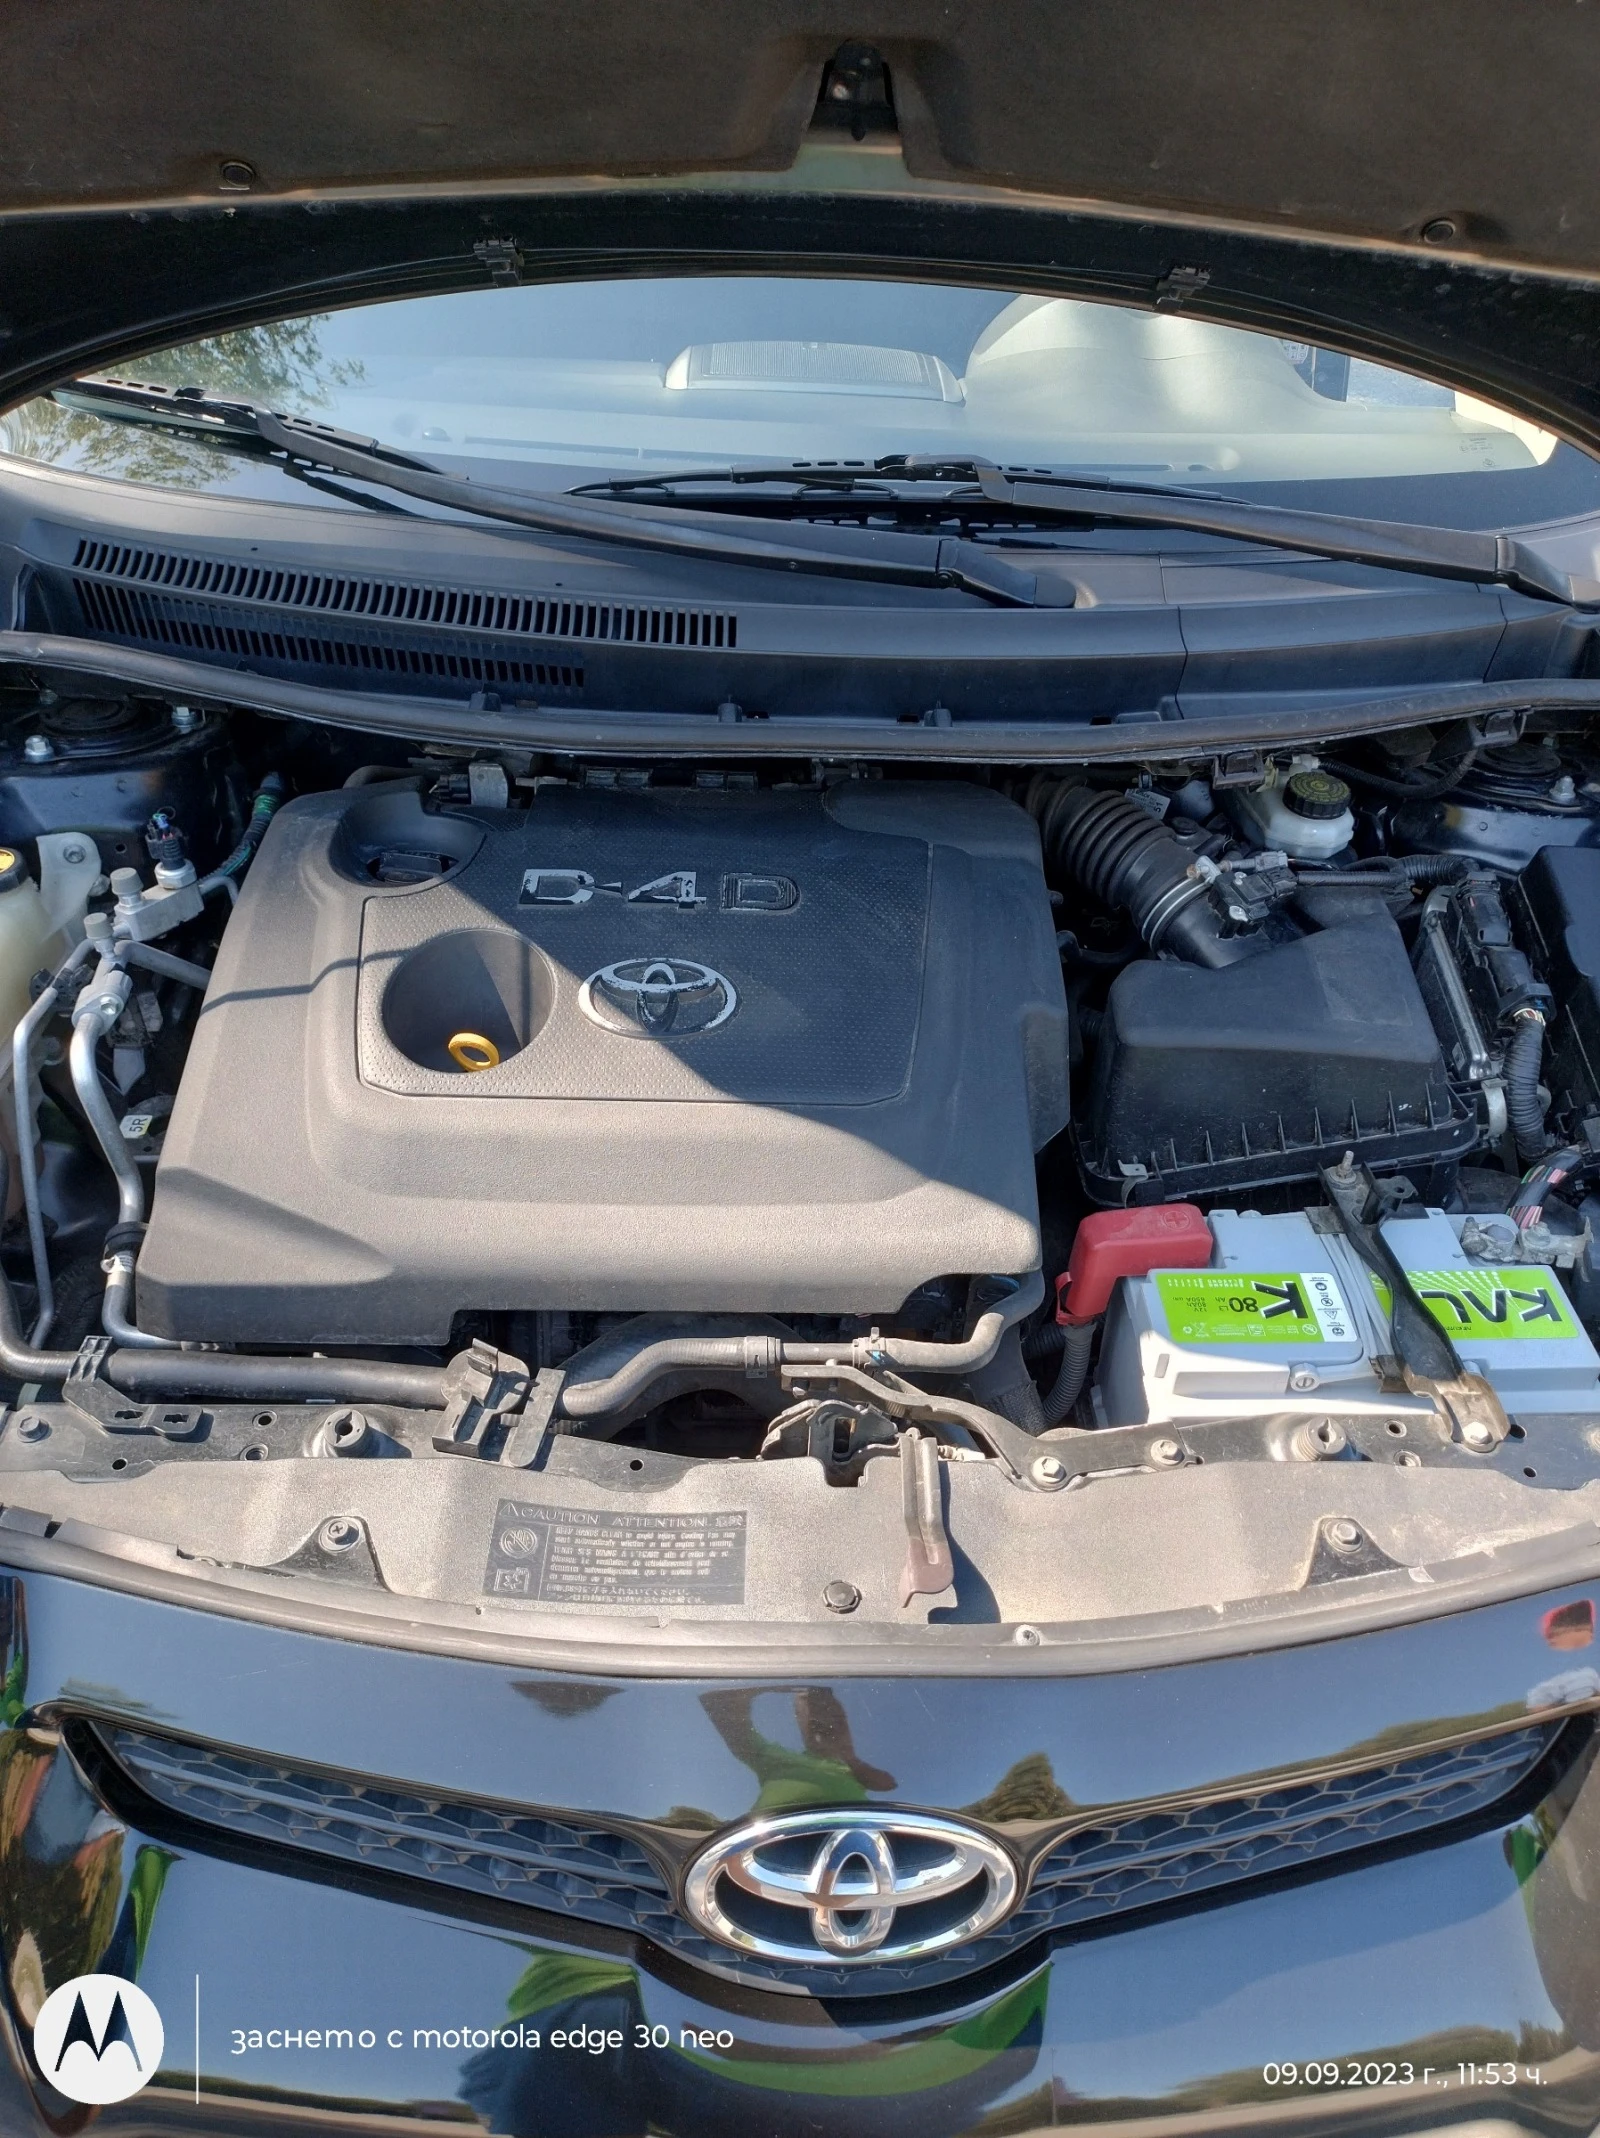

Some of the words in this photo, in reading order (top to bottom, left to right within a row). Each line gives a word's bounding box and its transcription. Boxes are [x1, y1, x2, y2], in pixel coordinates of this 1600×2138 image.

[129, 1118, 148, 1132] 5R
[1228, 1297, 1259, 1313] 80
[521, 1508, 599, 1525] CAUTION
[612, 1515, 708, 1528] ATTENTION
